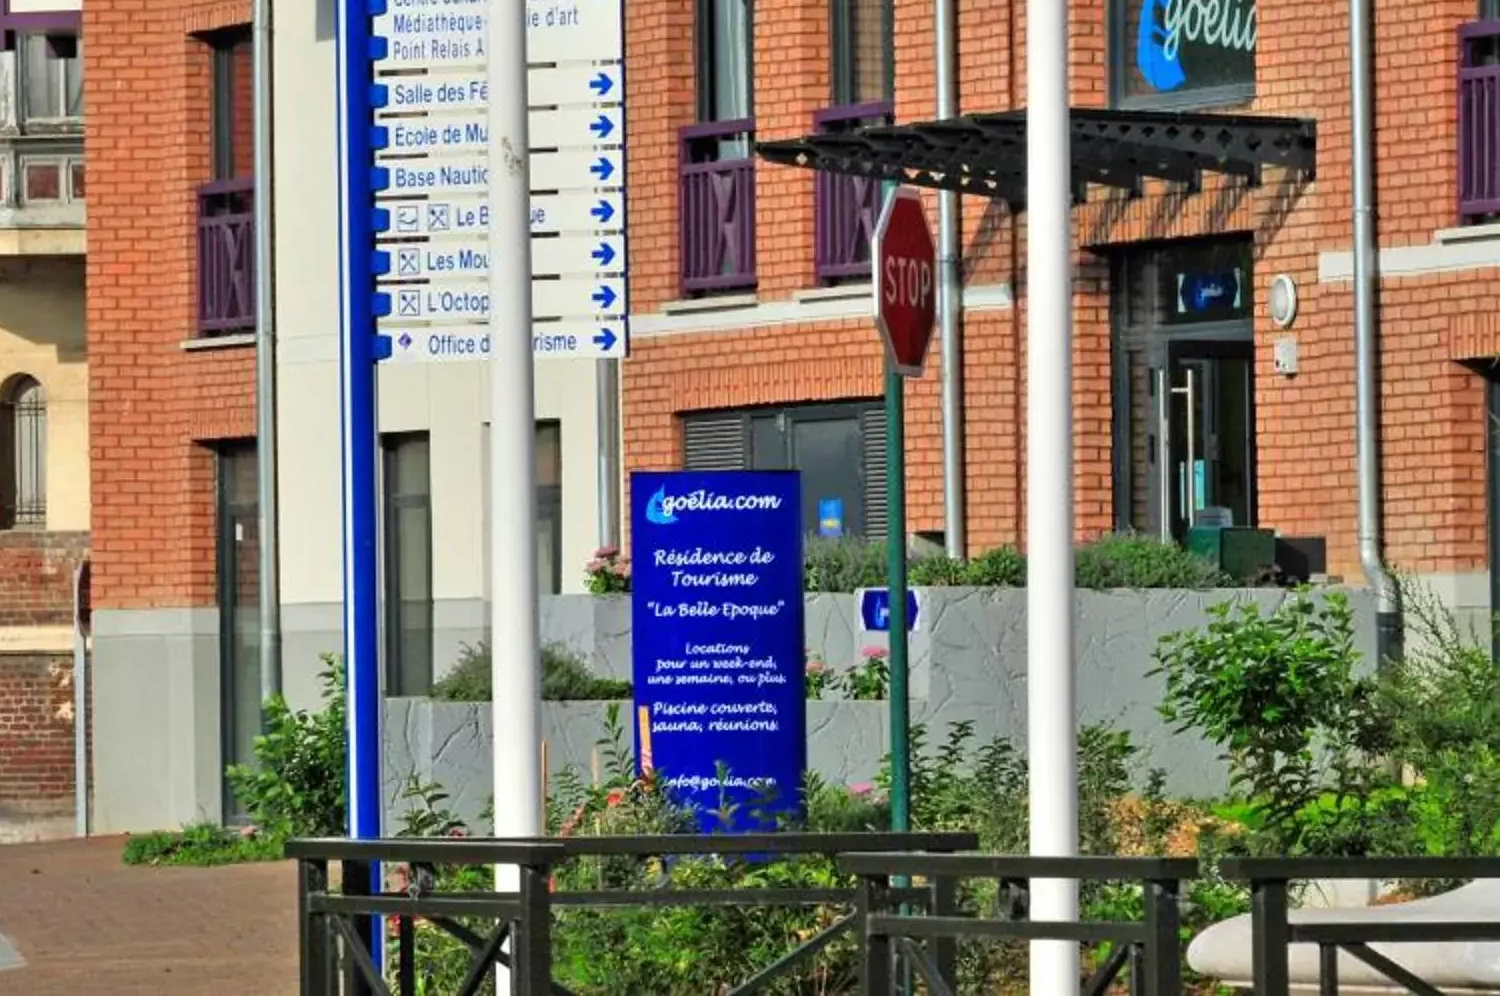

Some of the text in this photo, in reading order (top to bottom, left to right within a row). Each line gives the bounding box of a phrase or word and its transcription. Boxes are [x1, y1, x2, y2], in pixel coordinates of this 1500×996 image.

[545, 5, 580, 27] d'art
[393, 41, 425, 60] Point
[431, 39, 470, 59] Relais
[395, 84, 432, 105] Salle
[438, 81, 465, 102] des
[443, 124, 461, 145] de
[465, 123, 488, 143] Mu
[395, 169, 435, 188] Base
[457, 207, 475, 227] Le
[427, 251, 455, 271] Les
[885, 255, 931, 309] STOP
[428, 334, 474, 355] Office
[532, 333, 577, 353] risme
[654, 546, 775, 567] Résidence de
[671, 571, 759, 587] Tourisme
[679, 602, 719, 617] Belle
[685, 642, 750, 655] Locations
[656, 659, 686, 673] pour
[647, 676, 673, 685] une
[737, 676, 756, 684] ou
[653, 701, 708, 715] Piscine
